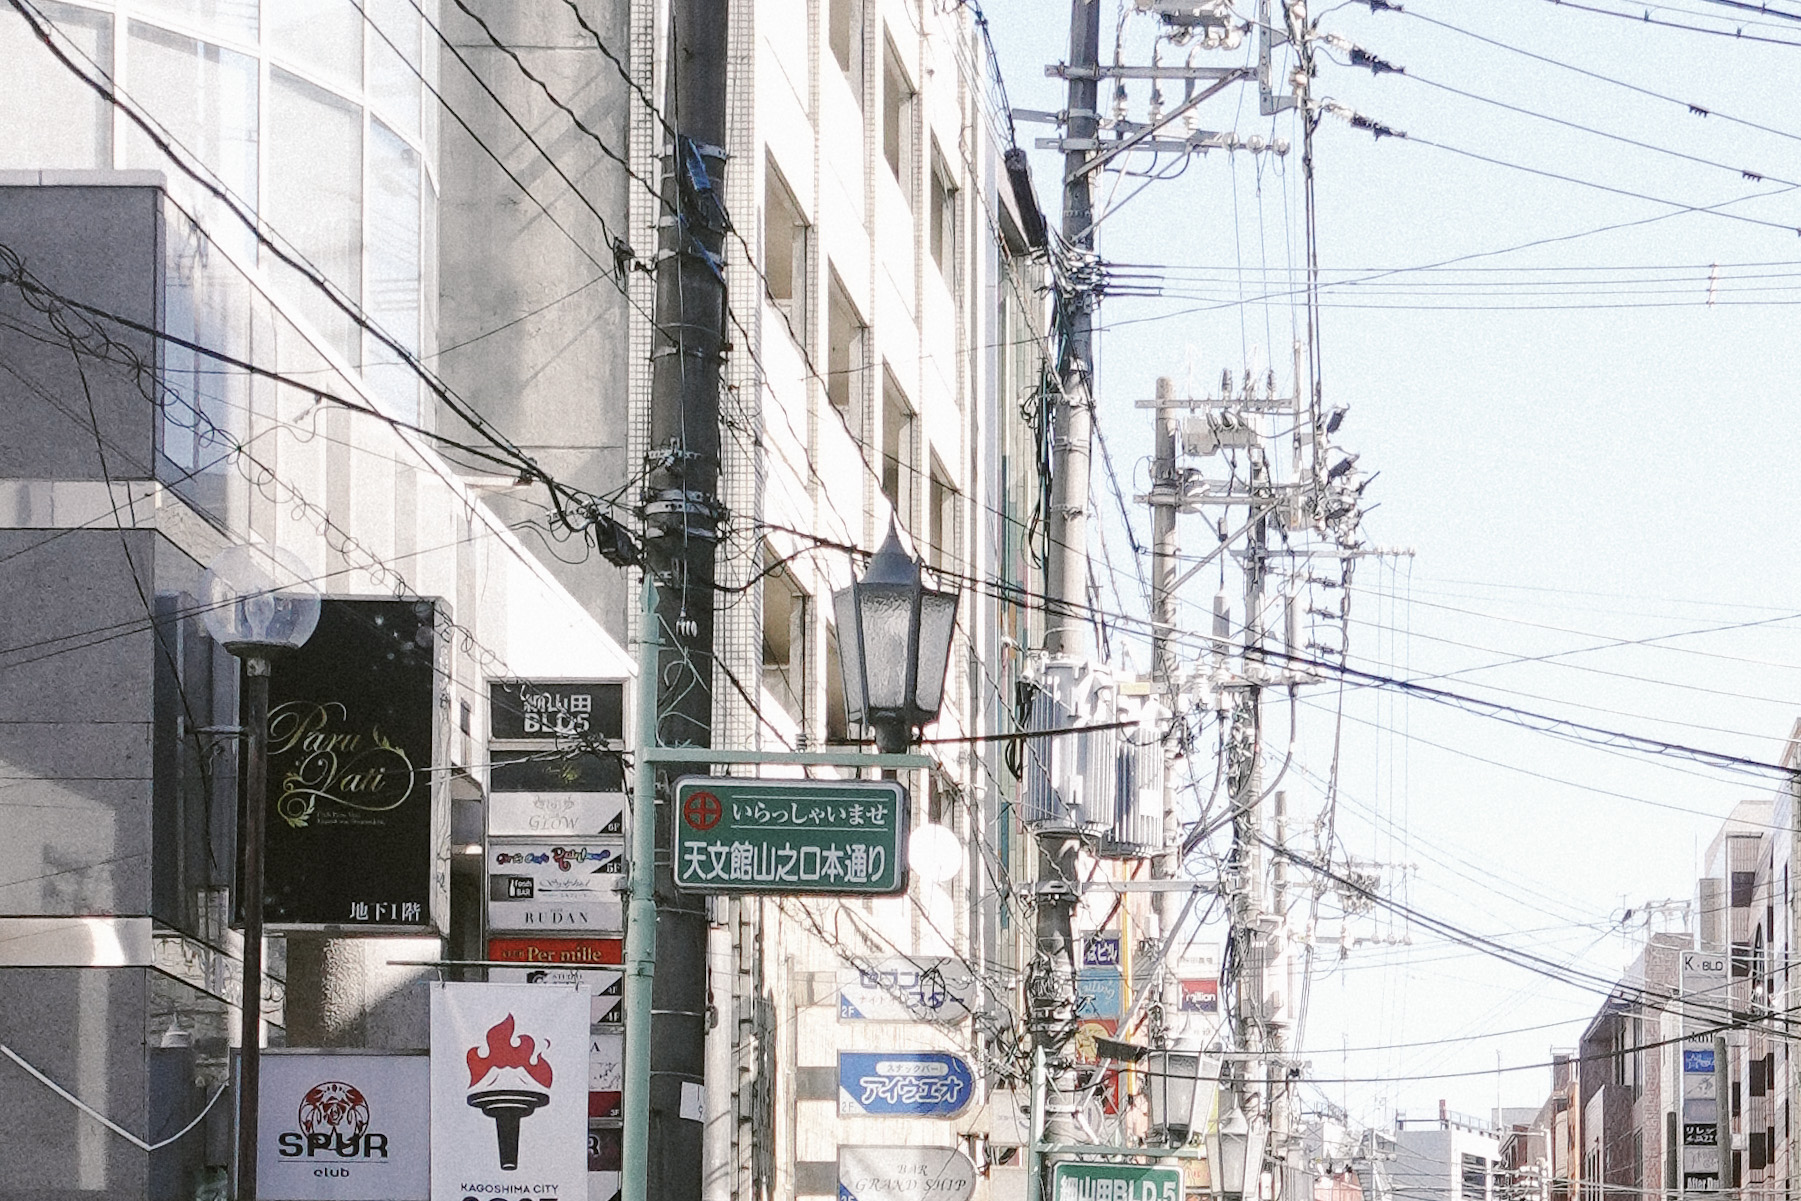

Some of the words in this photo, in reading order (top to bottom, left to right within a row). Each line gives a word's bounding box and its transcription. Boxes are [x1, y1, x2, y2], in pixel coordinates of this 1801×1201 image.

[732, 800, 888, 826] いらっしゃいませ
[528, 815, 580, 831] GLOW
[682, 839, 886, 883] 天文館山之口本通り
[525, 911, 589, 925] RUDAN
[527, 946, 557, 962] Per
[560, 946, 603, 962] mille
[841, 1006, 855, 1017] 2F
[860, 1076, 964, 1105] アイウエオ
[278, 1131, 389, 1159] SPUR
[313, 1167, 350, 1178] club
[898, 1164, 928, 1177] BAR
[460, 1183, 530, 1194] KAGOSHIMA
[533, 1183, 559, 1195] CITY
[855, 1178, 918, 1193] GRAND
[924, 1178, 967, 1192] SHIP
